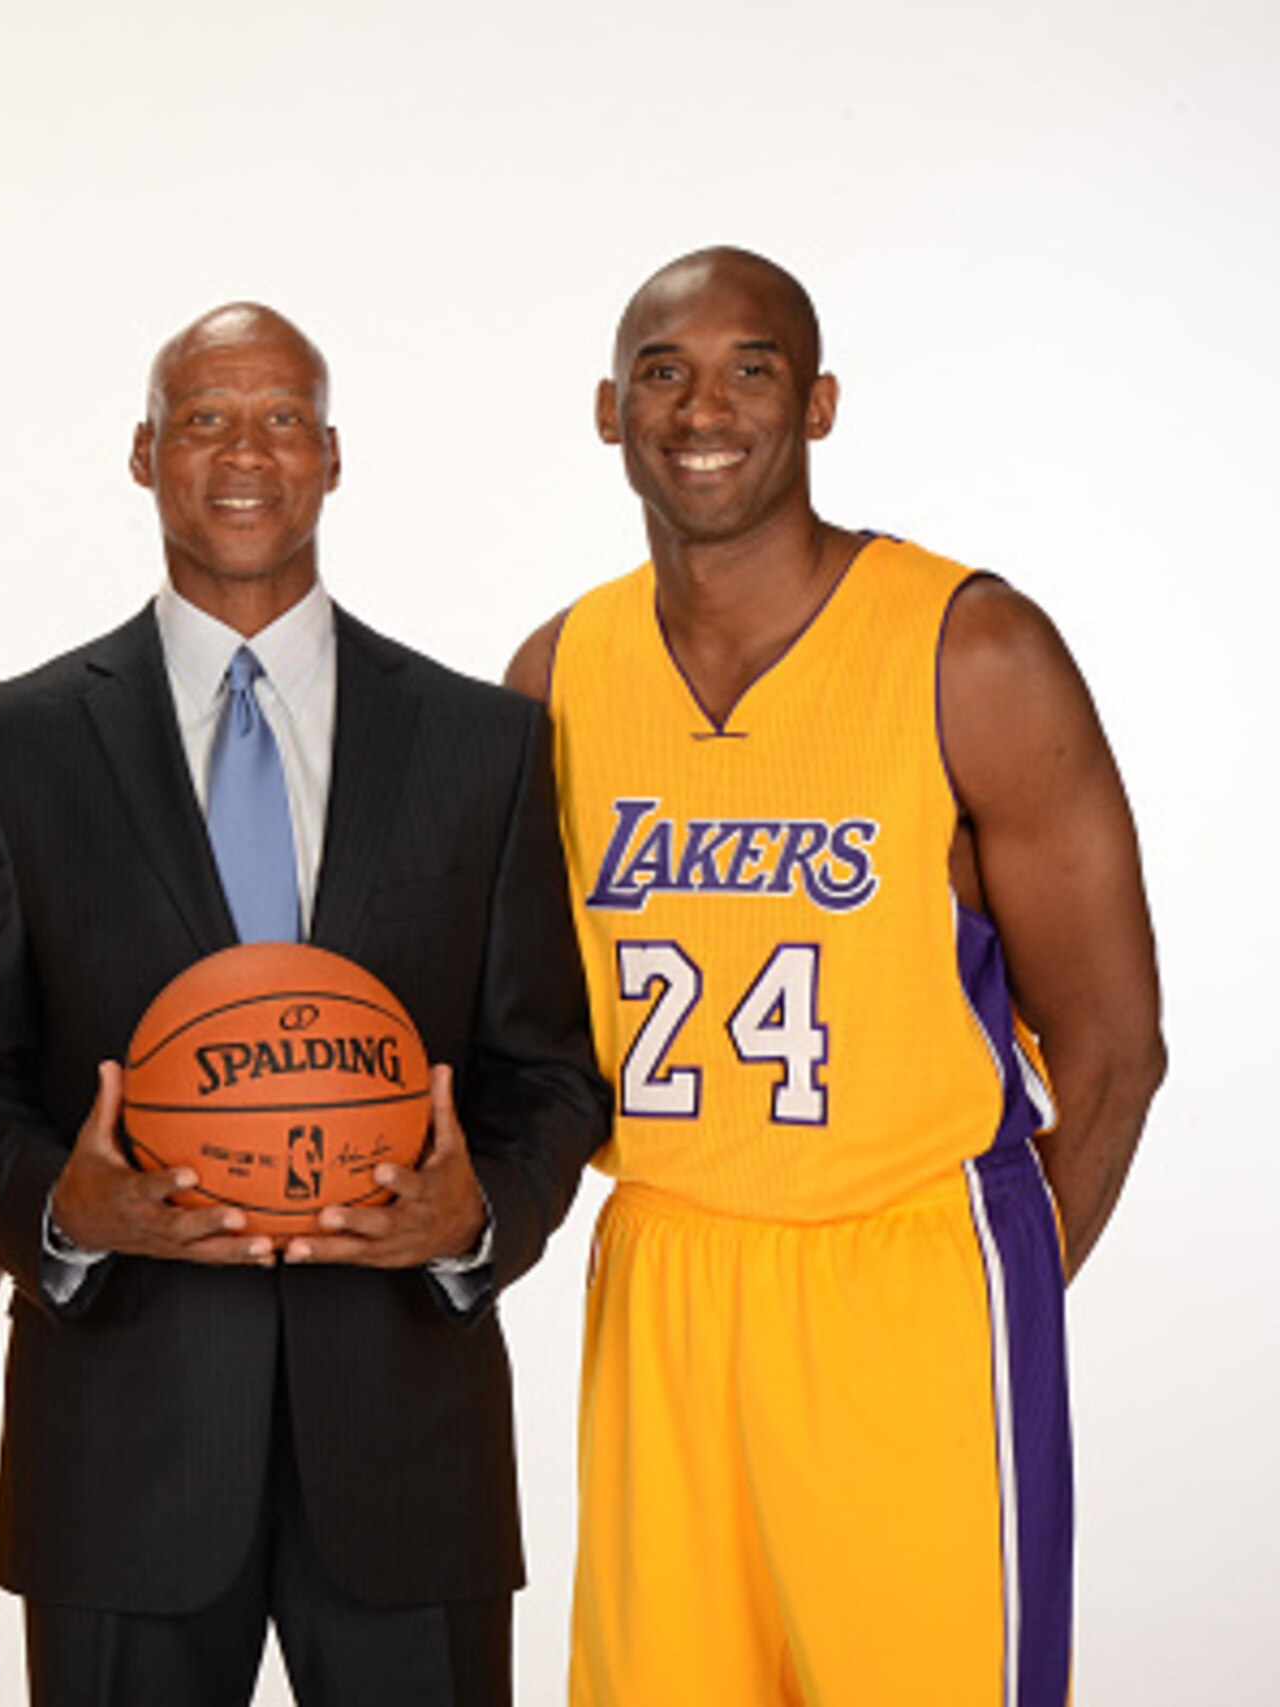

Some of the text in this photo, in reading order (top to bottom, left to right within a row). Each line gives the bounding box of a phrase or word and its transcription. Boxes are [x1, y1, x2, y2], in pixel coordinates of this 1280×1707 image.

[586, 798, 878, 914] LAKERS
[195, 1037, 405, 1095] SPALDING
[616, 940, 828, 1126] 24
